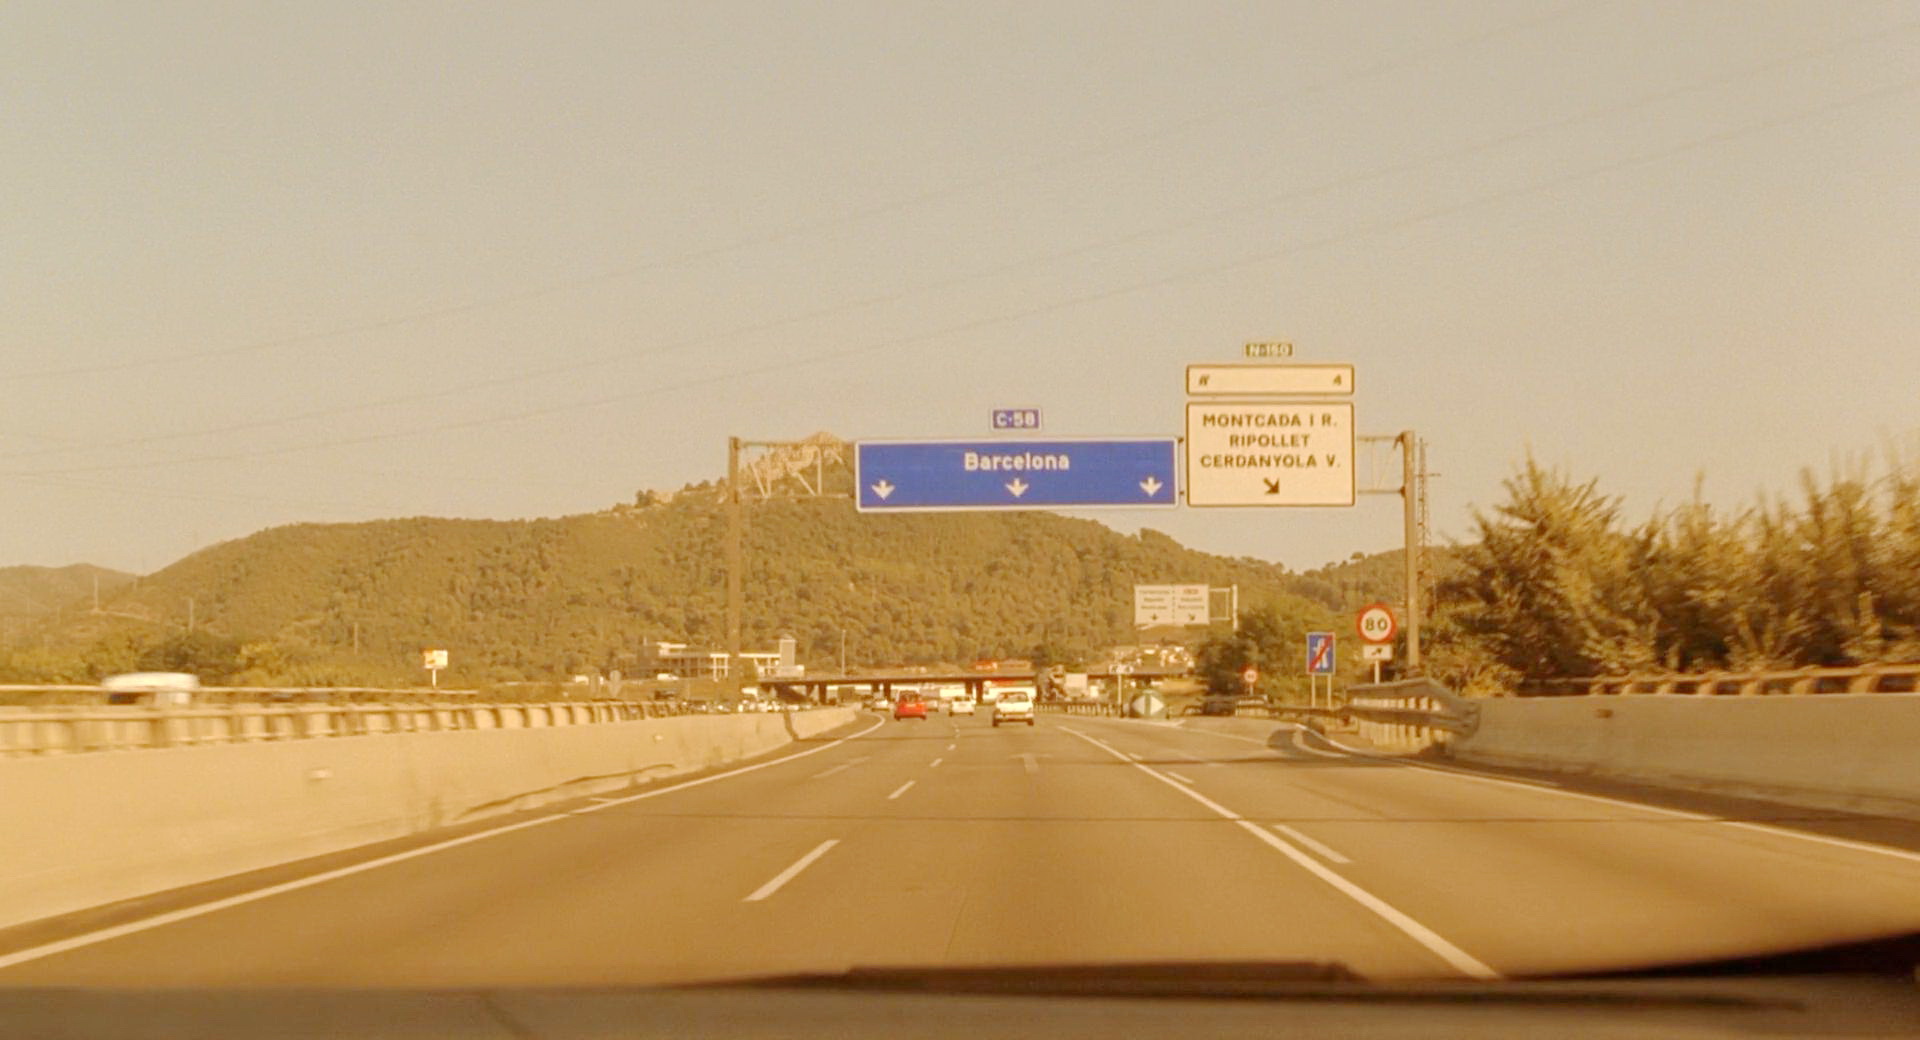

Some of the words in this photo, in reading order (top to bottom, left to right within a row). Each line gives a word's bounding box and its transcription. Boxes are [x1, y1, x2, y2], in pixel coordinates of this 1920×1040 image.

[1202, 413, 1302, 427] MONTCADA
[1309, 414, 1314, 427] I
[1321, 414, 1338, 427] R.
[1229, 434, 1310, 448] RIPOLLET
[964, 451, 1070, 471] Barcelona
[1200, 454, 1317, 468] CERDANYOLA
[1326, 454, 1341, 468] V.
[1365, 617, 1388, 631] 80
